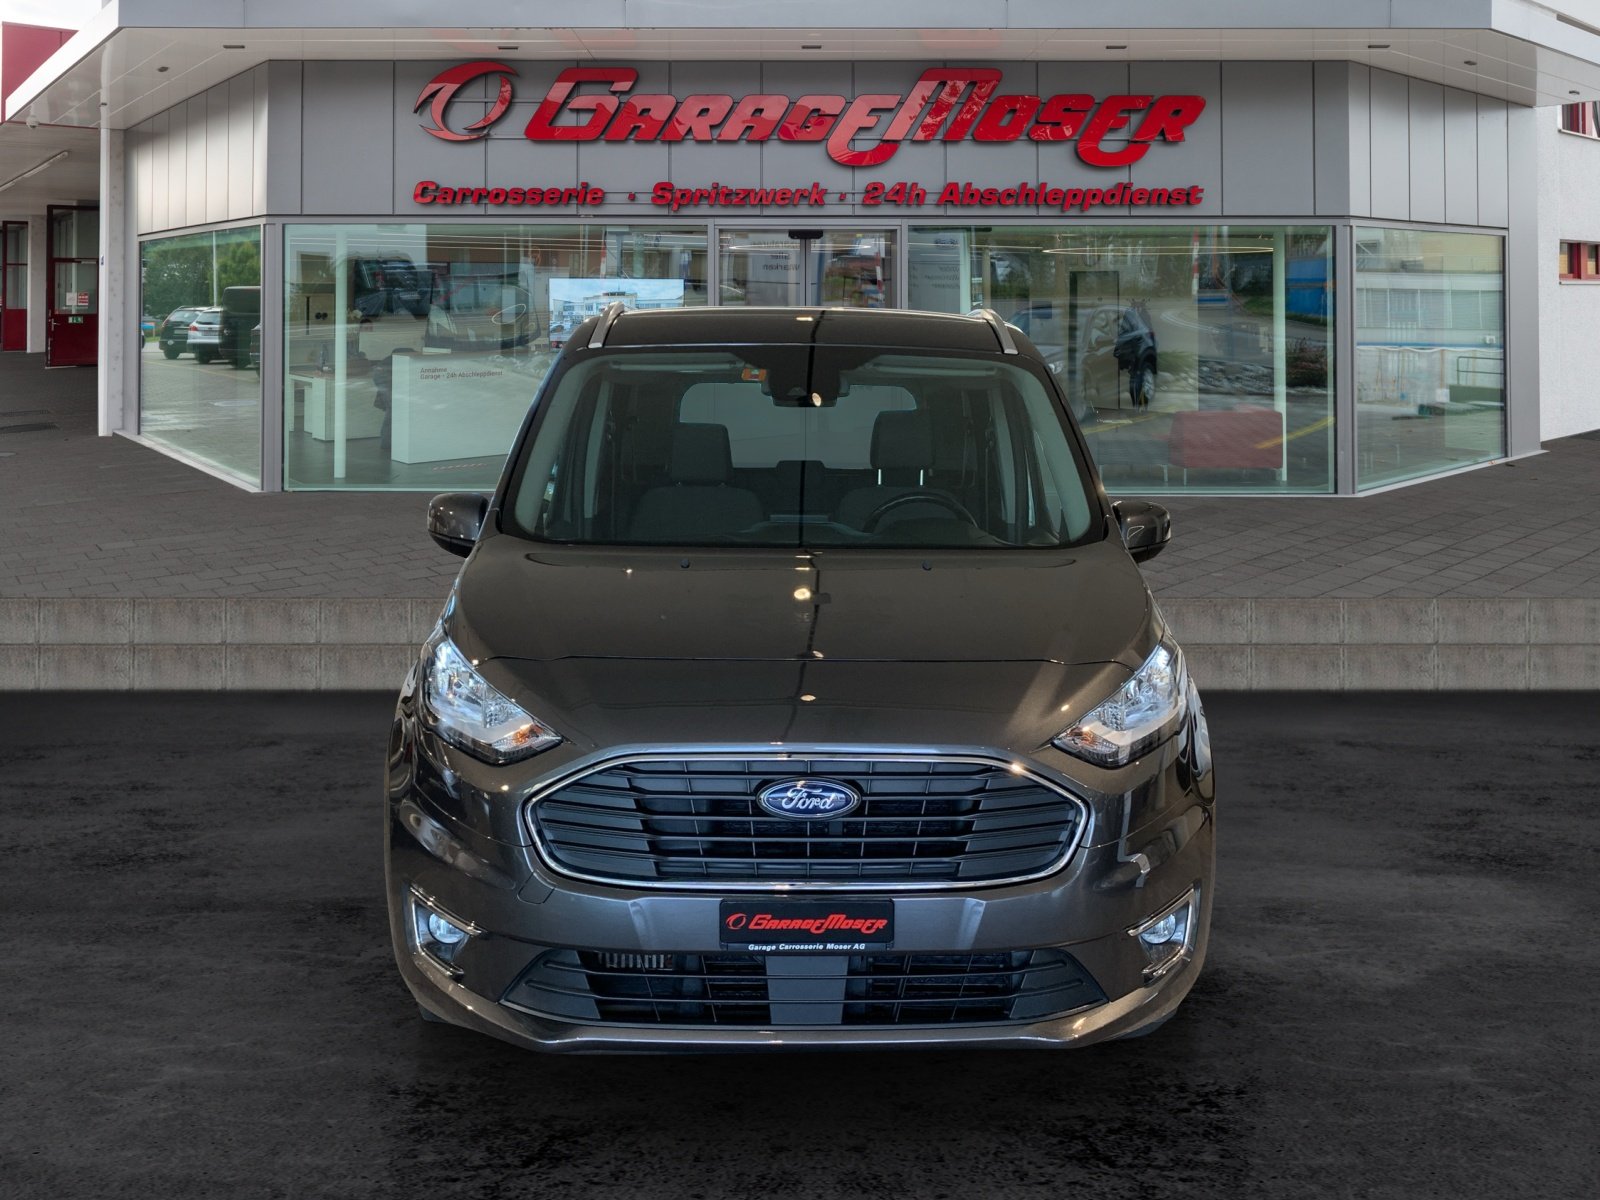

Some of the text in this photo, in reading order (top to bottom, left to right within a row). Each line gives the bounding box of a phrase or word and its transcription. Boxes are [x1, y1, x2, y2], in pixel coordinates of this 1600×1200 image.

[413, 181, 1204, 212] Carrosserie Spritzwerk 24h Abschleppdienst
[458, 370, 503, 378] Abschleppdienst
[782, 787, 835, 809] Ford
[748, 943, 776, 951] Garage
